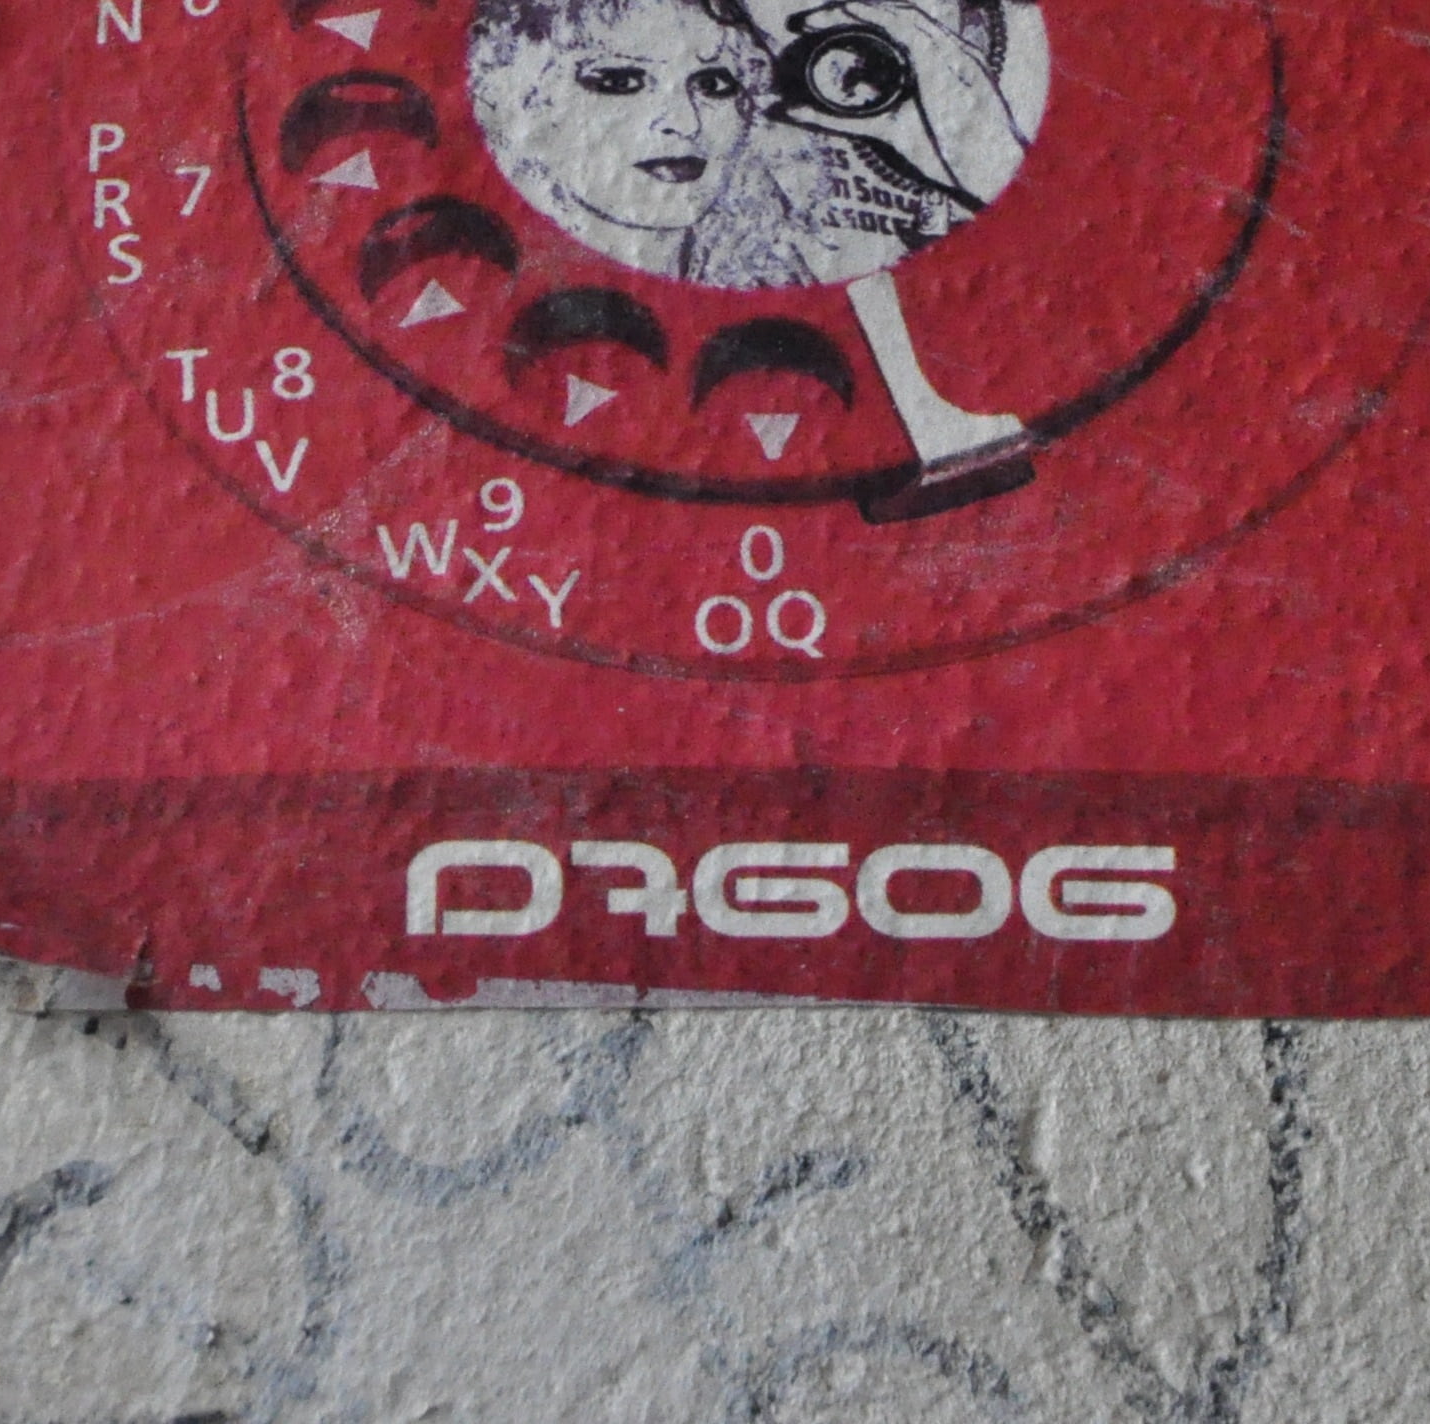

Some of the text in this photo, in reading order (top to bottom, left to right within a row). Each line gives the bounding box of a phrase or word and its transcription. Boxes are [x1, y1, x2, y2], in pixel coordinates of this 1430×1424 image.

[173, 165, 213, 218] 7
[271, 345, 316, 401] 8
[479, 476, 525, 533] 9
[375, 518, 581, 630] WXY
[693, 589, 828, 659] OQ
